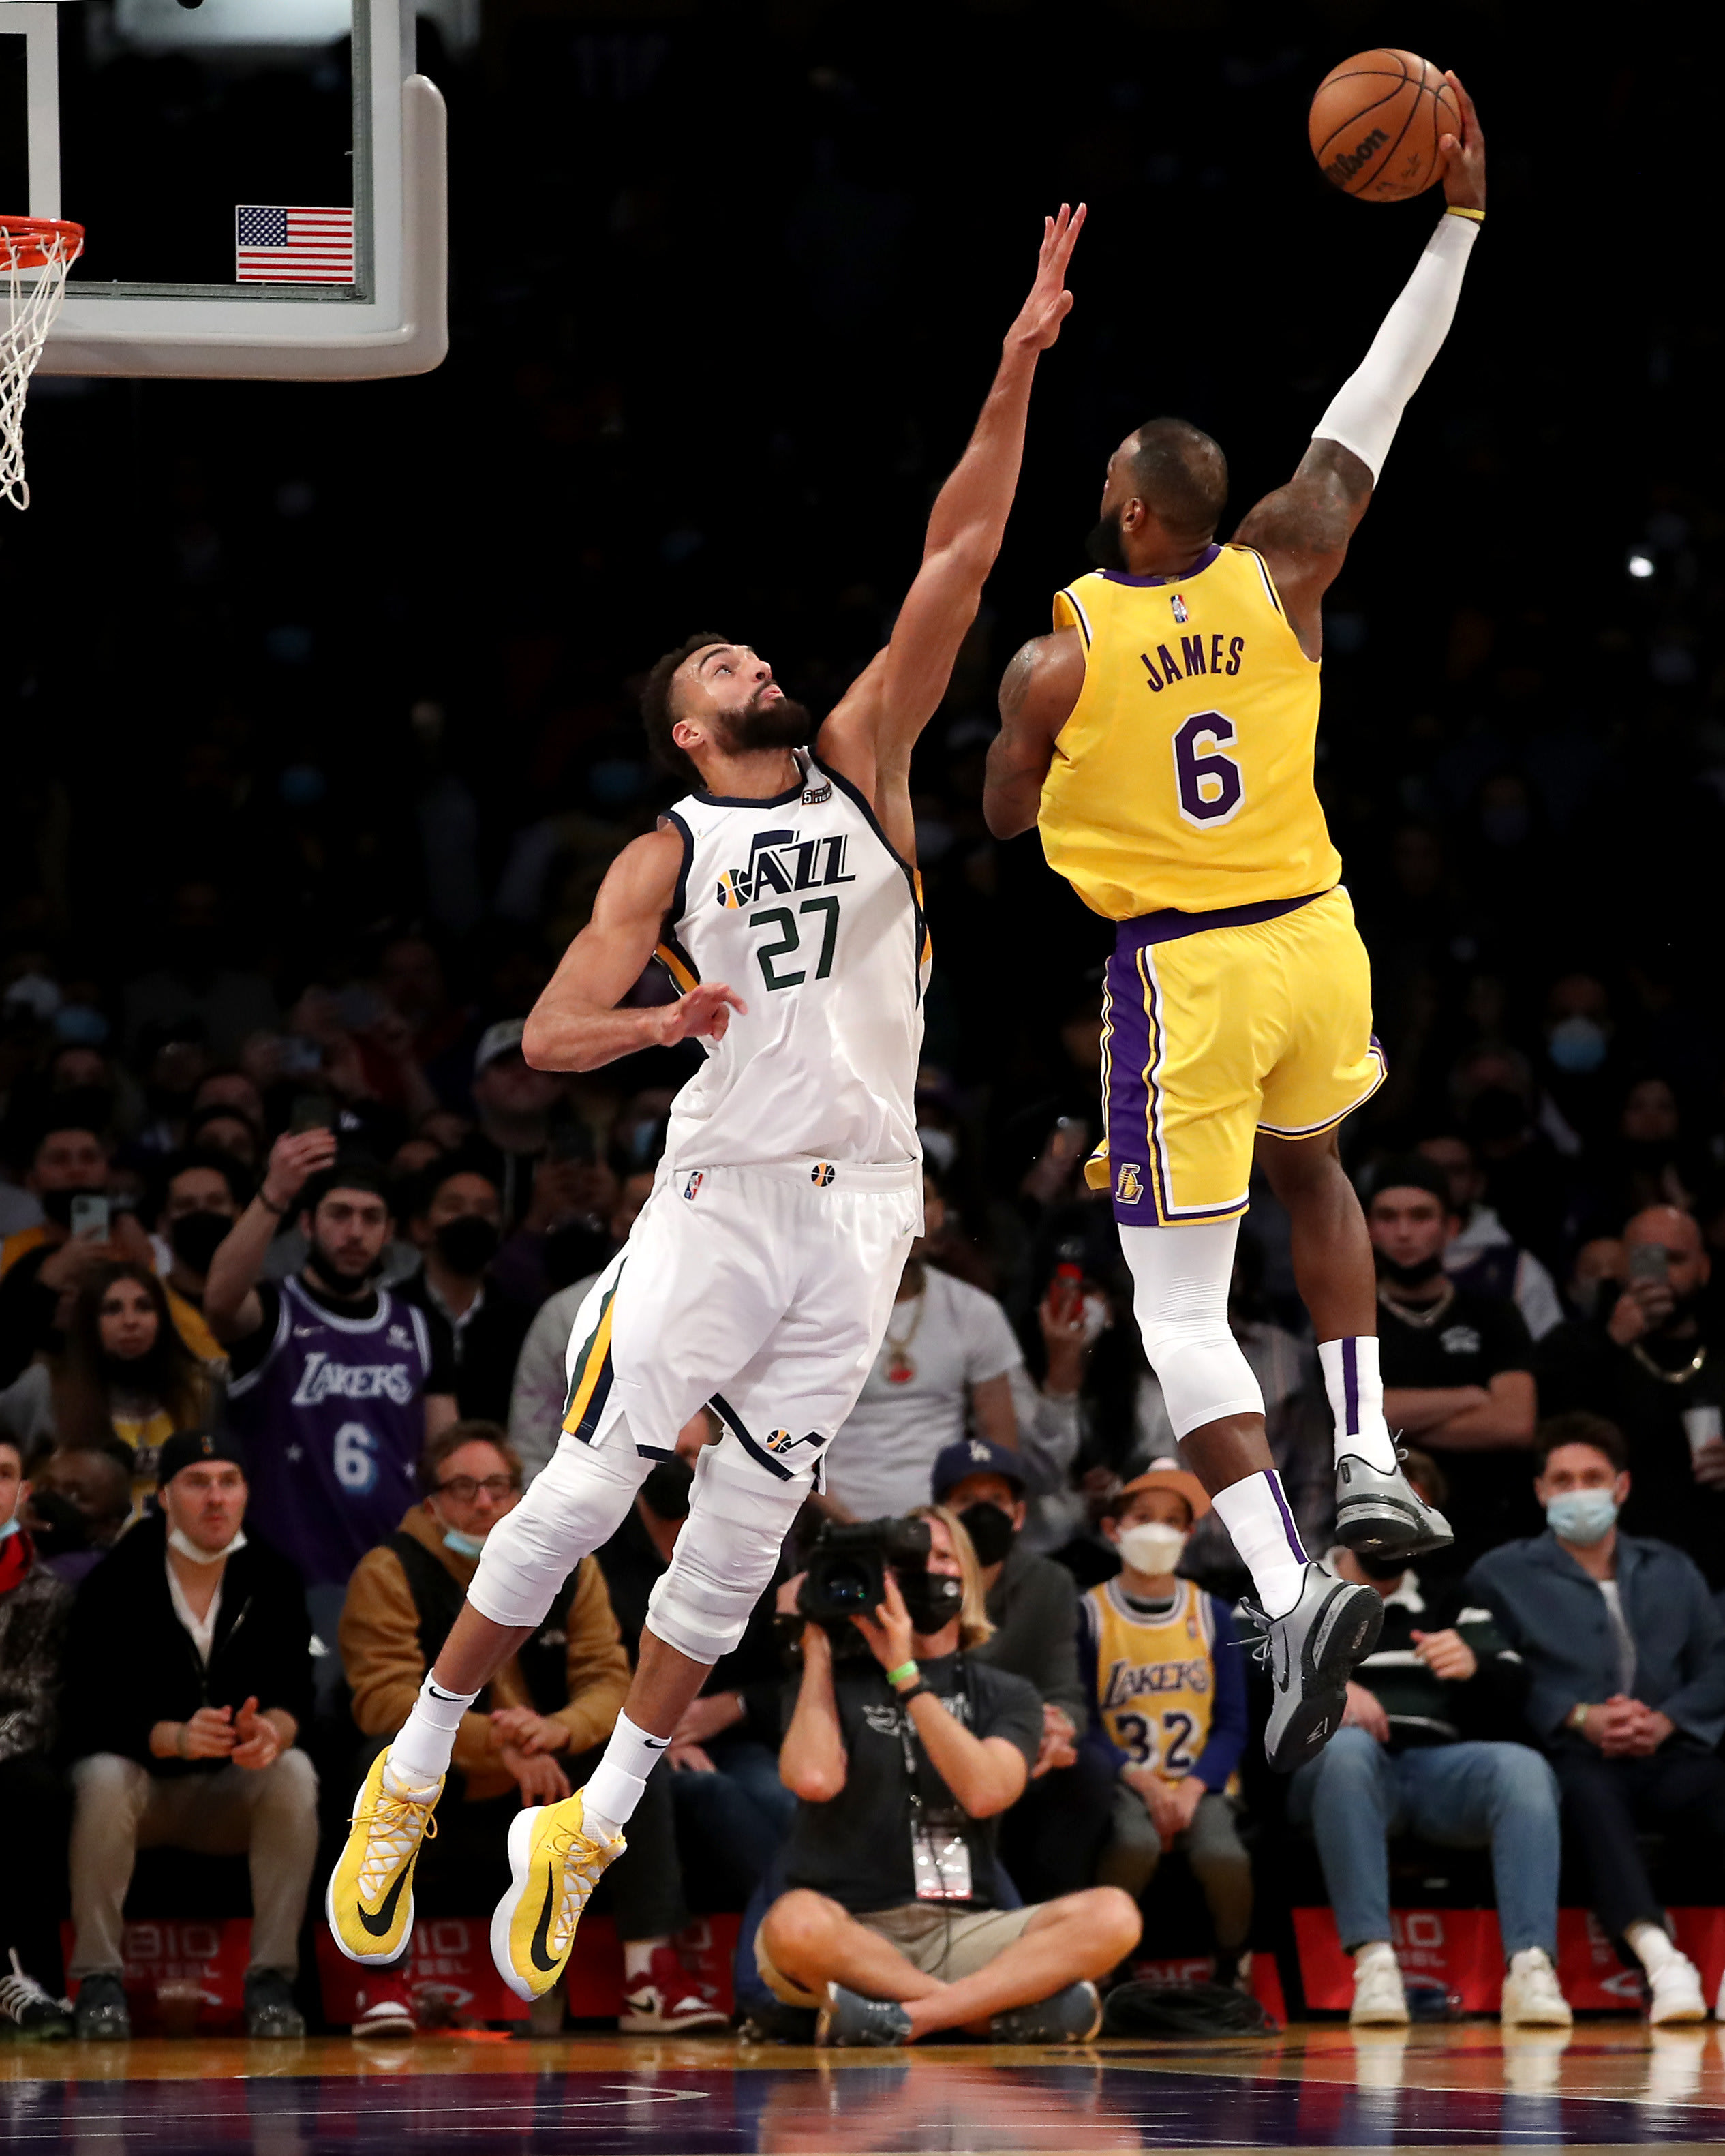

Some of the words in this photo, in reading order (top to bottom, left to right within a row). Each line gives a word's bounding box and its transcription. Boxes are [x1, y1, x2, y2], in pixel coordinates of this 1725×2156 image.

[1140, 634, 1245, 692] JAMES
[804, 791, 812, 804] 5
[1172, 710, 1245, 829] 6
[717, 829, 856, 909] JAZZ
[749, 895, 840, 991] 27
[291, 1352, 414, 1406] LAKERS
[333, 1422, 377, 1495] 6
[1100, 1658, 1210, 1711] LAKERS
[1114, 1710, 1194, 1774] 32
